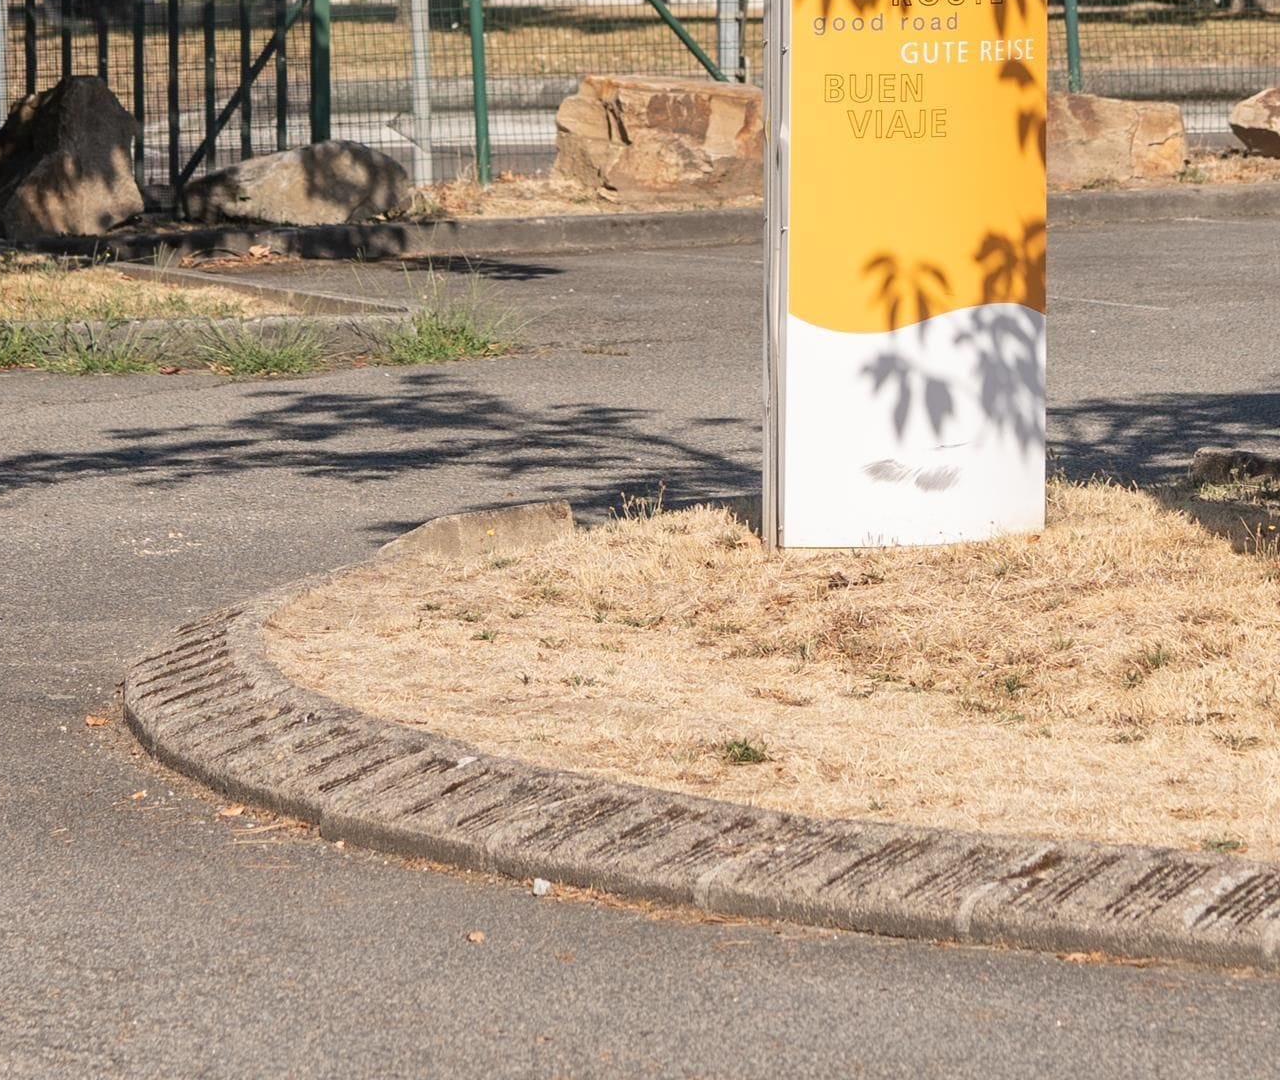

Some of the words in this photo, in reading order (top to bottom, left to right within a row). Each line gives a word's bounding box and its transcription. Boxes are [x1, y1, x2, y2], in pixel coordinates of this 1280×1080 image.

[813, 13, 884, 36] good
[900, 11, 958, 31] road
[900, 41, 969, 64] GUTE
[980, 39, 1035, 62] REISE
[824, 73, 924, 103] BUEN
[847, 108, 948, 139] VIAJE
